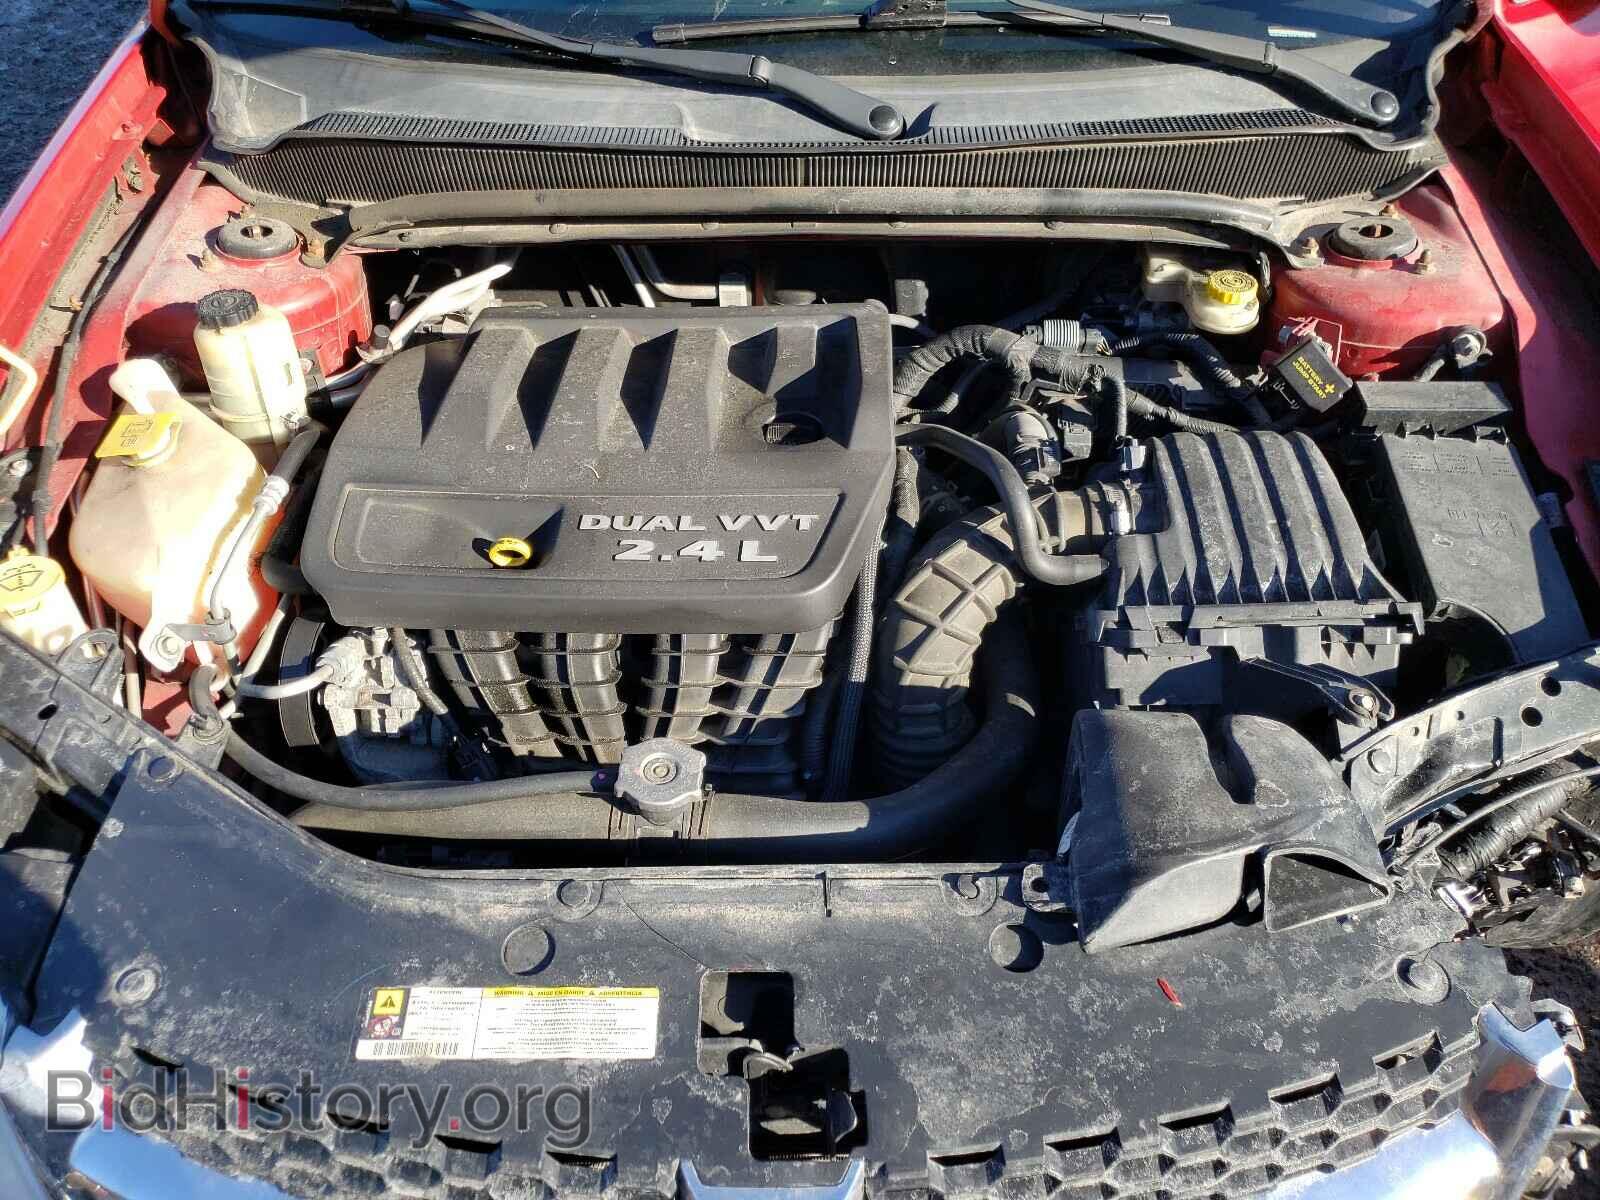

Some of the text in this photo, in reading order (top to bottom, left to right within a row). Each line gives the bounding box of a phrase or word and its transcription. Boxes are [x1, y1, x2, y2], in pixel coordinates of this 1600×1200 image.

[1292, 360, 1327, 399] JUMP START
[1296, 356, 1324, 385] BATTERY
[578, 514, 822, 531] DUAL VVT
[612, 539, 778, 562] 2.4 L
